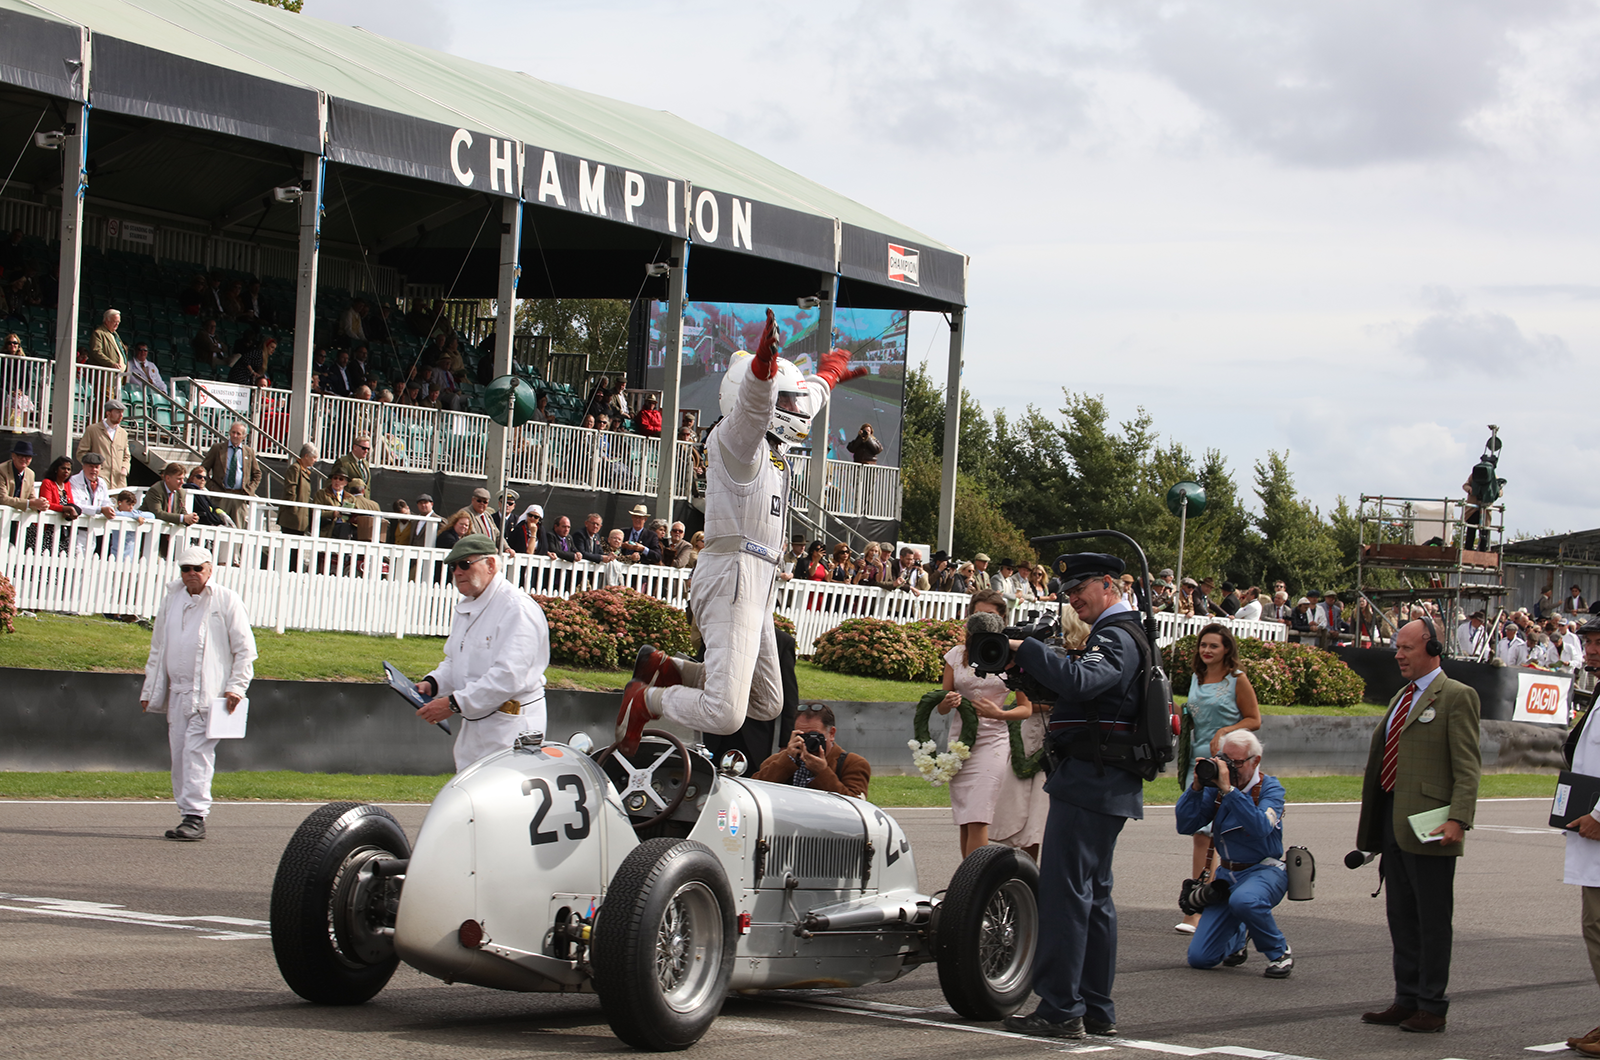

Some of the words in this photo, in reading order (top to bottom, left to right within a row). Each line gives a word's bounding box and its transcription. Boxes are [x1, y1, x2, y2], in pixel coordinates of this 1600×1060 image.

[450, 128, 753, 250] CHAMPION
[890, 256, 917, 273] CHAMPION
[1528, 687, 1558, 711] PAGID
[521, 773, 590, 846] 23
